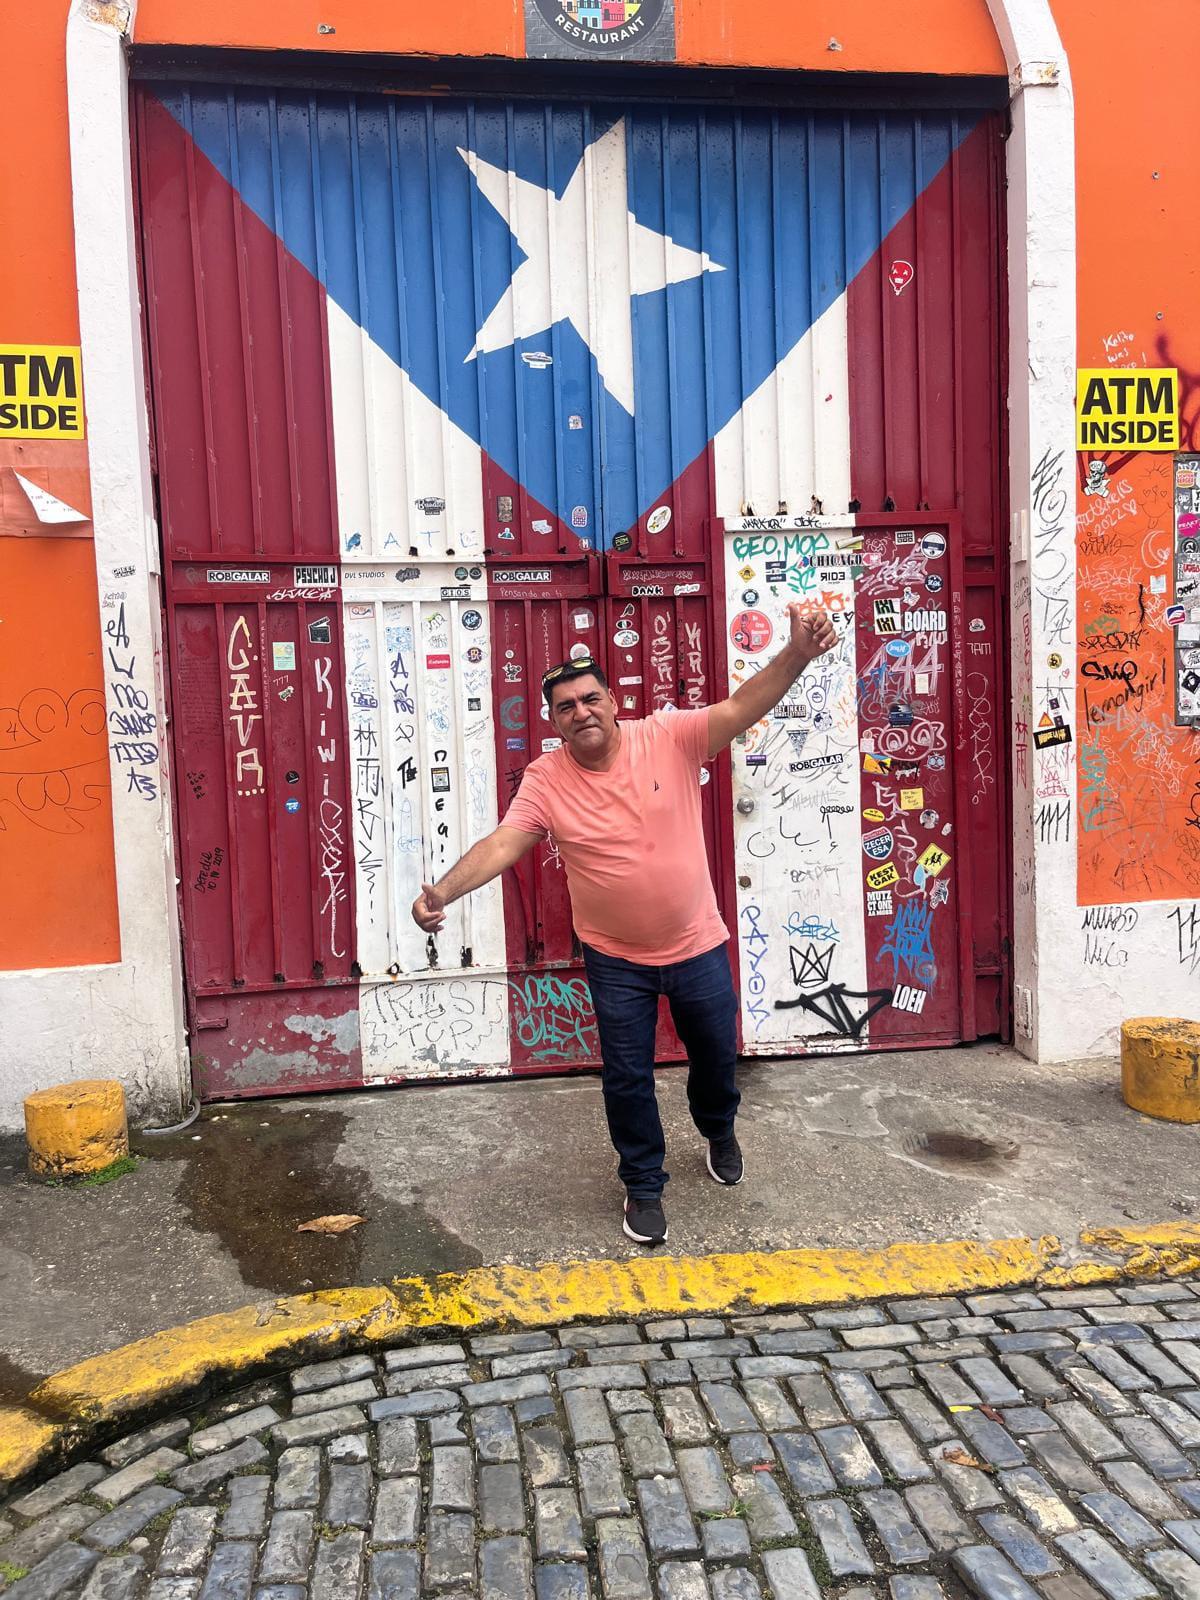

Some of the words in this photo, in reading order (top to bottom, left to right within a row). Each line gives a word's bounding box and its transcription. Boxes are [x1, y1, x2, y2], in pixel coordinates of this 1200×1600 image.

[554, 13, 645, 44] RESTAURANT
[1081, 377, 1174, 415] ATM
[1081, 421, 1174, 444] INSIDE
[809, 554, 863, 567] CHICAGO
[358, 571, 386, 579] STUDIOS
[499, 586, 538, 598] Pensando
[541, 590, 551, 598] en
[904, 610, 947, 632] BOARD
[864, 835, 891, 850] ZECER
[872, 845, 889, 856] ESA
[869, 865, 895, 882] KEST
[873, 873, 895, 887] GAK
[866, 890, 892, 901] MUTZ
[891, 983, 927, 1014] LOEH
